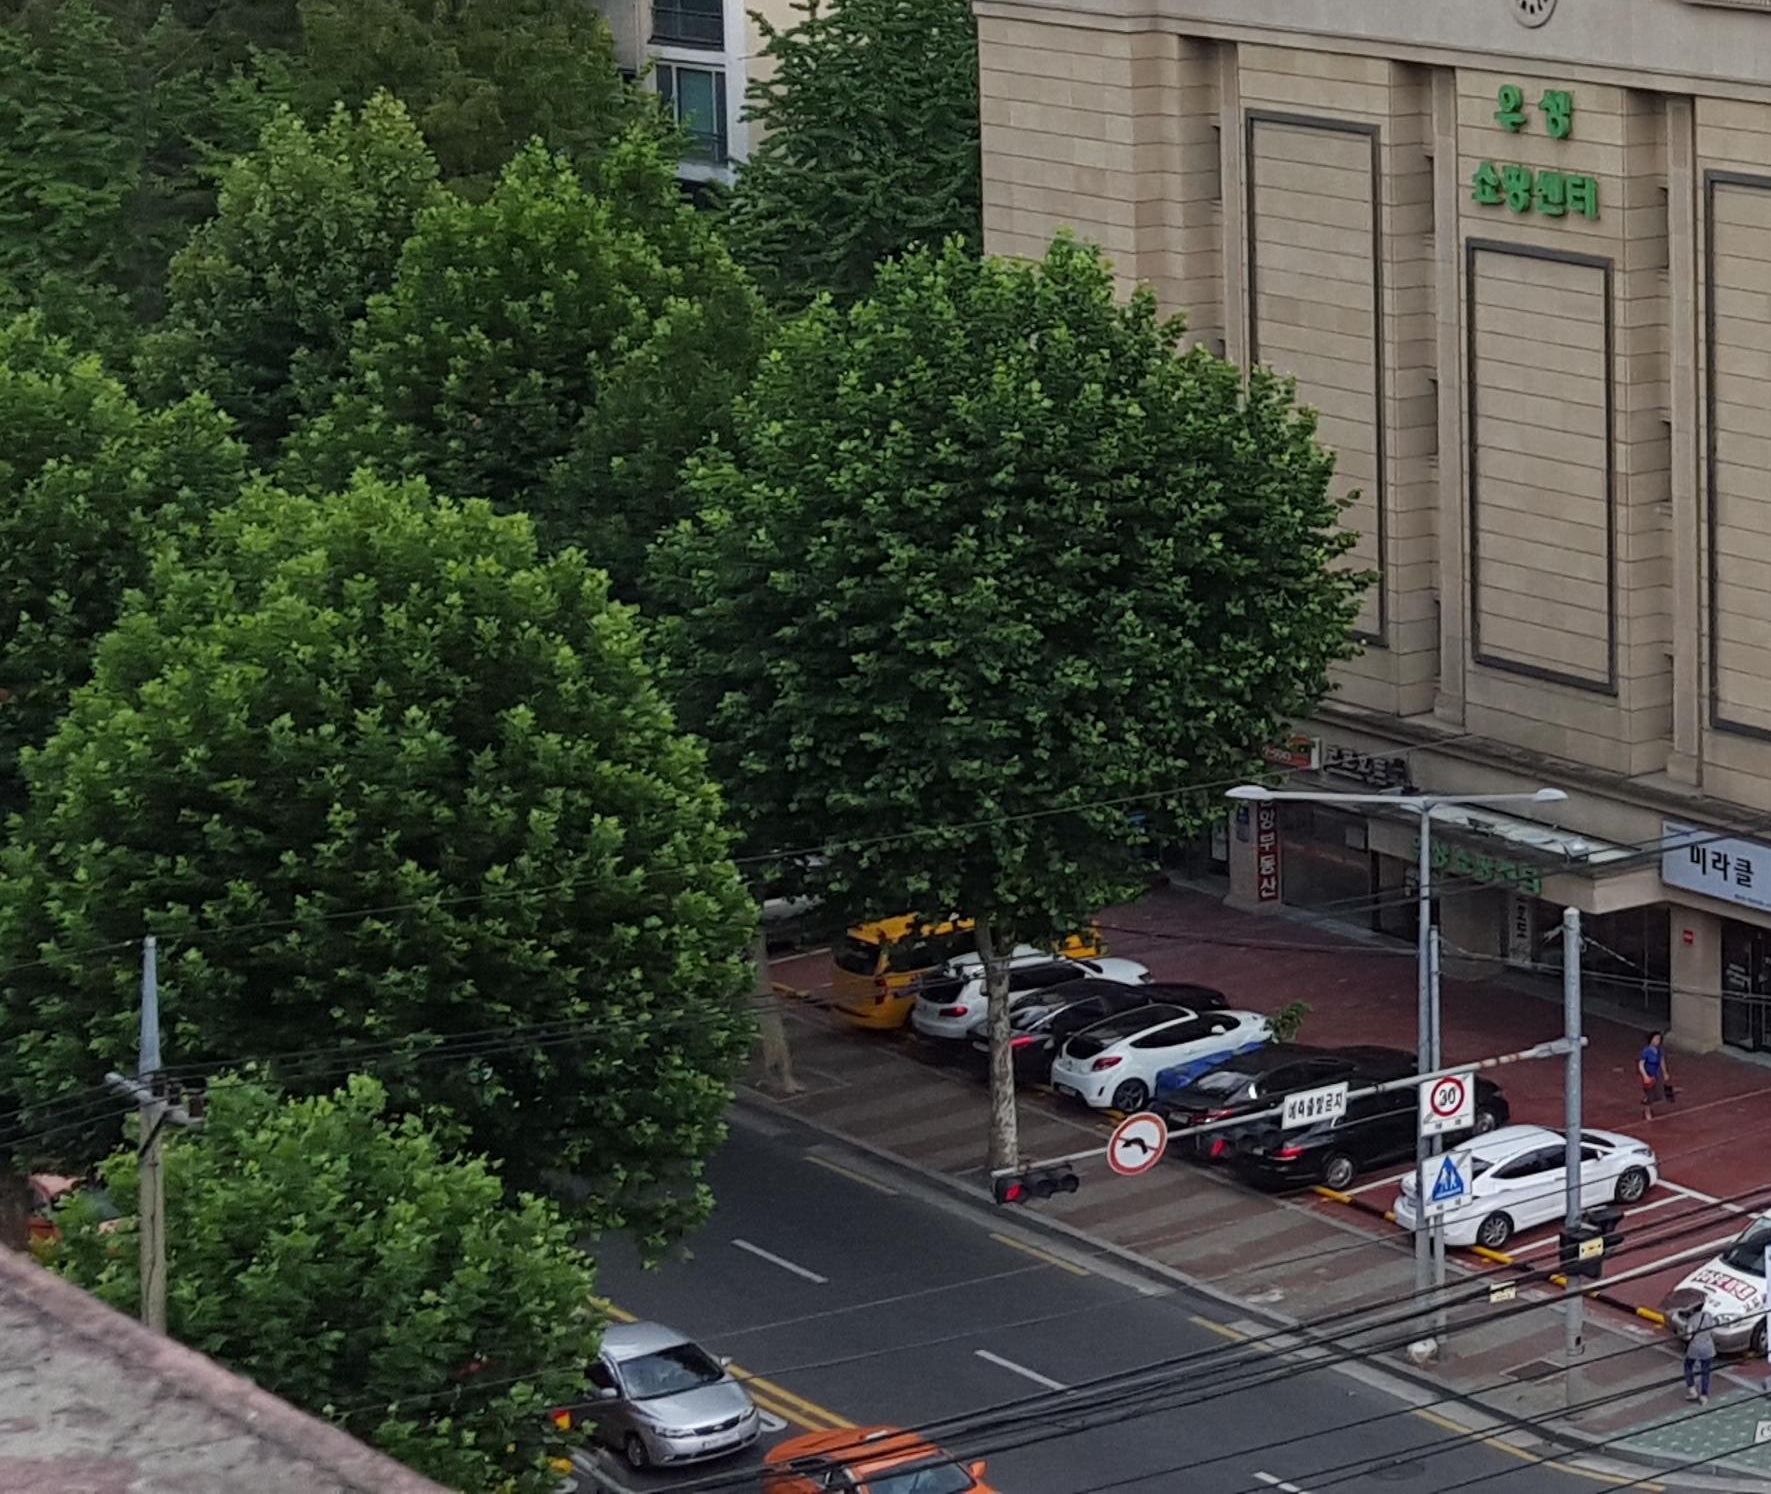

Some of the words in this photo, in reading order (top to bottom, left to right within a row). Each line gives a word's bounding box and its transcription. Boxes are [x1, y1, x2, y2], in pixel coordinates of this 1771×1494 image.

[1471, 160, 1601, 222] 쇼핑센터
[1689, 845, 1755, 890] 미라클
[1438, 1087, 1457, 1107] 30
